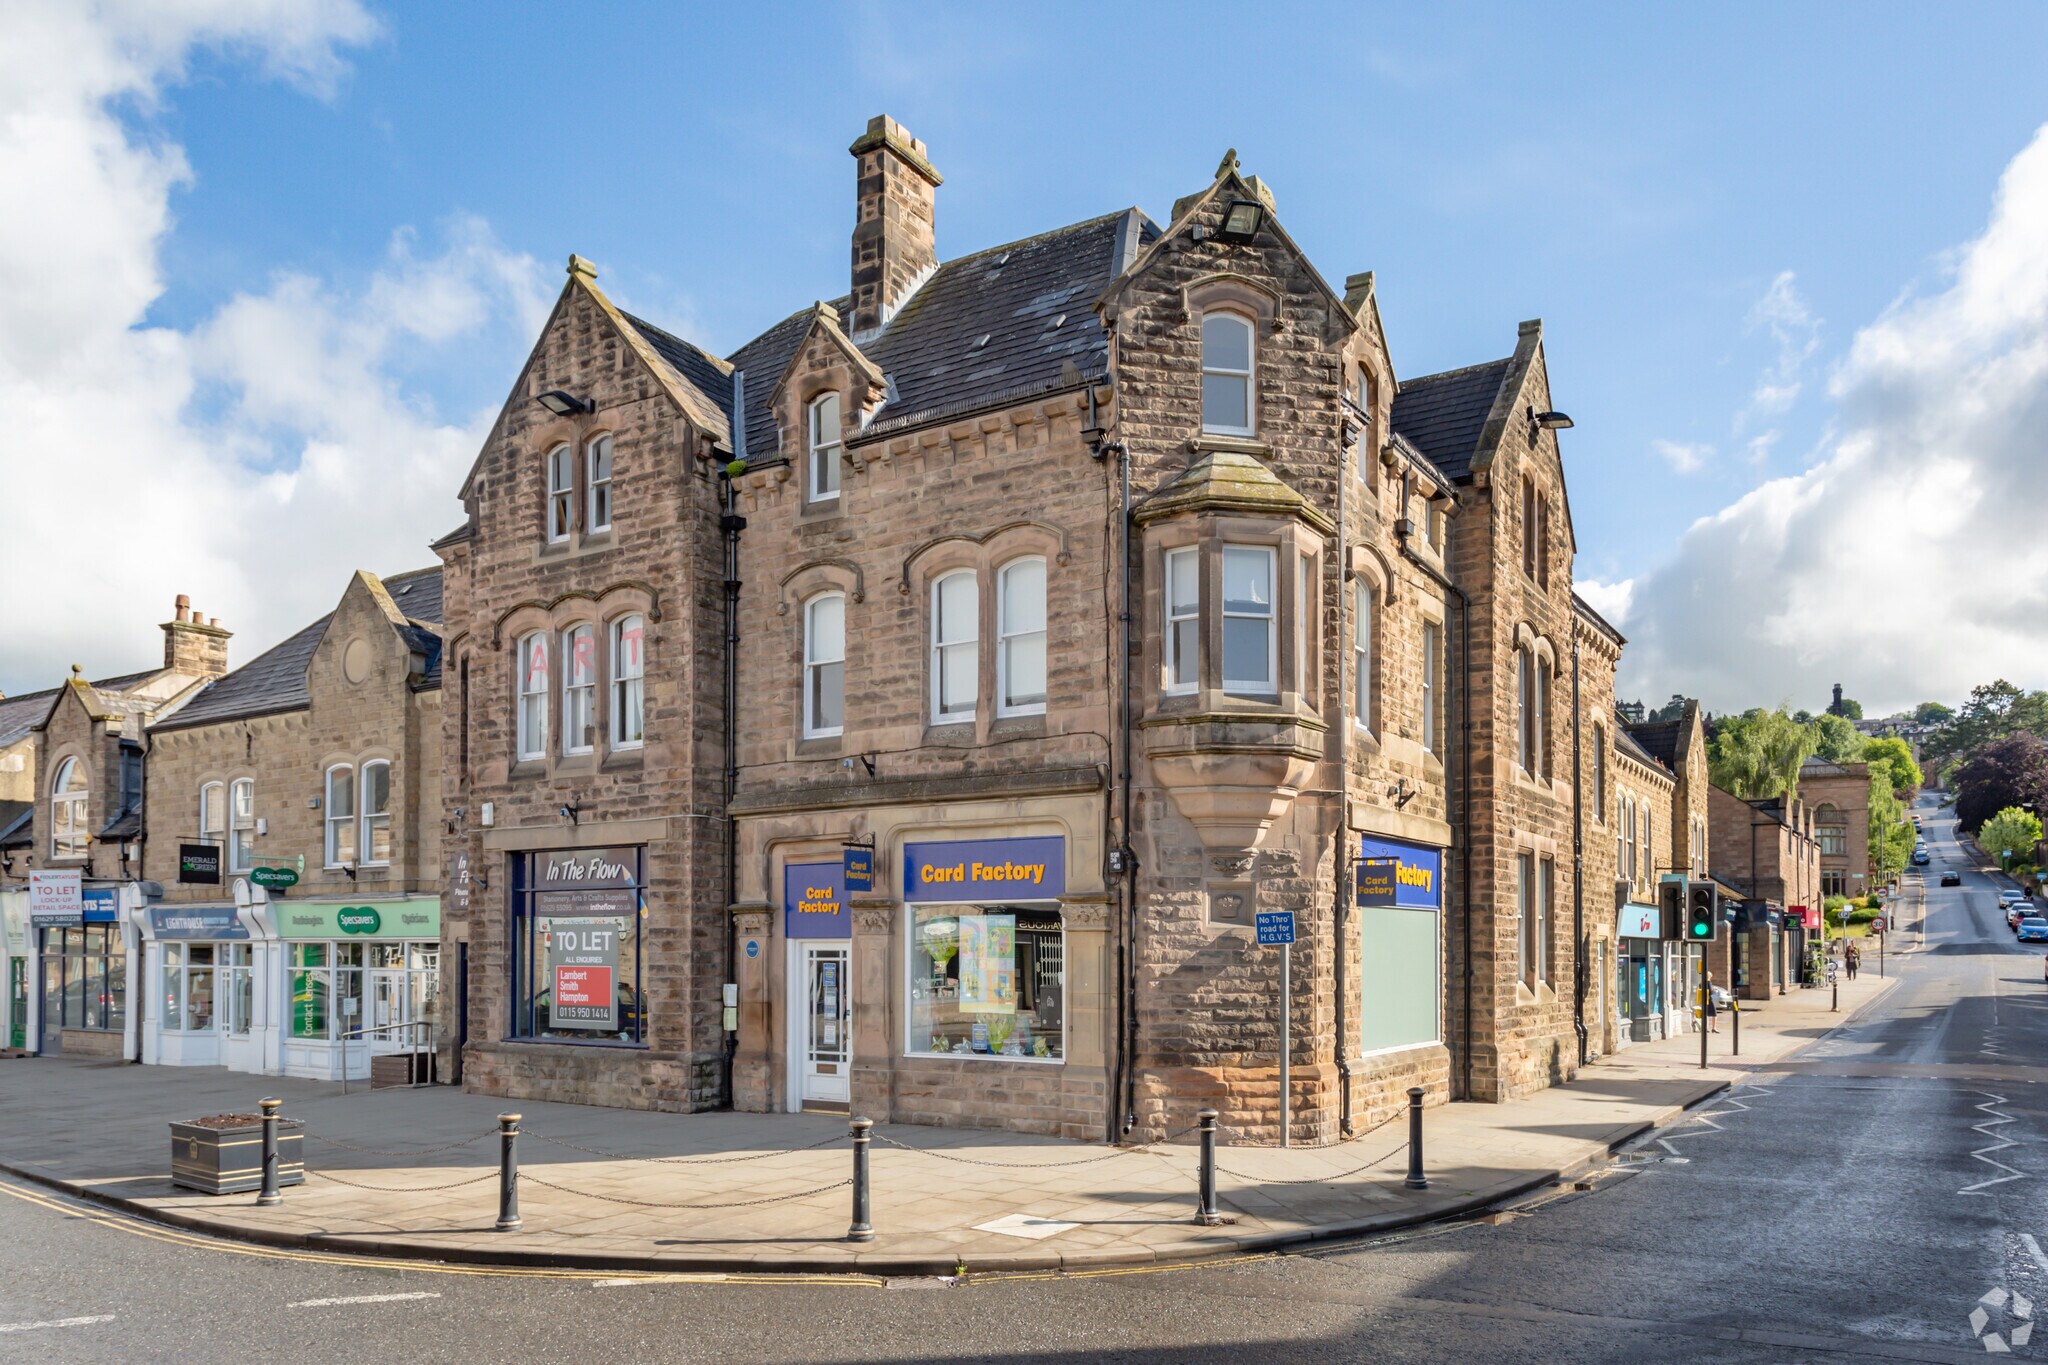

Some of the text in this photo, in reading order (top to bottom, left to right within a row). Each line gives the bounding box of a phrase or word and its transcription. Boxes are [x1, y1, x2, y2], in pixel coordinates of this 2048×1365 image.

[183, 856, 217, 864] EMERALD
[193, 863, 216, 871] GREEN
[546, 858, 622, 880] In The Flow
[851, 862, 867, 870] Card
[255, 871, 295, 881] Specsavers
[846, 870, 871, 882] Factory
[921, 862, 1045, 884] Card Factory
[1396, 860, 1432, 893] Factory
[1365, 876, 1388, 885] Card
[36, 886, 76, 895] TO LET
[806, 886, 833, 900] Card
[1358, 886, 1394, 896] Factory
[572, 894, 582, 902] Arts
[798, 901, 840, 915] Factory
[340, 914, 374, 926] Specsavers
[1259, 915, 1290, 924] No Thro'
[1873, 920, 1884, 928] 30
[1279, 924, 1290, 932] for
[556, 932, 612, 951] TO LET
[576, 956, 603, 964] ENQUIRIES
[560, 970, 587, 980] Lambert
[304, 972, 313, 1002] Lenses
[560, 981, 578, 991] Smith
[560, 992, 588, 1003] Hampton
[560, 1007, 608, 1018] 0115 950 1414
[304, 1004, 313, 1036] Contact
